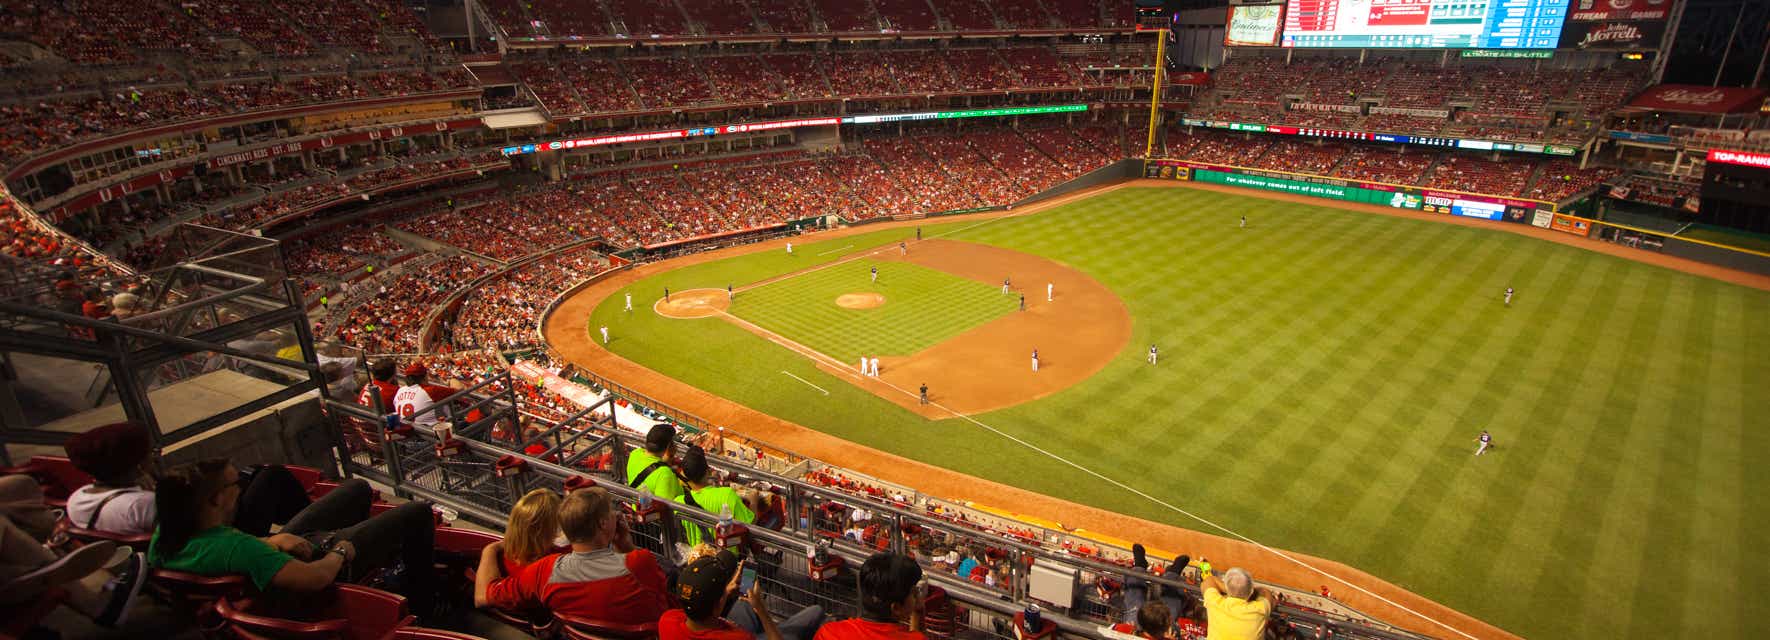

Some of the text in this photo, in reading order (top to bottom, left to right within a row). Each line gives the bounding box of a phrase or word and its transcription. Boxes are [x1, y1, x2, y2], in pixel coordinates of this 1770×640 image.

[1572, 12, 1608, 20] STREAM
[1578, 27, 1638, 48] Morrell
[1238, 178, 1265, 187] whatever
[1311, 186, 1324, 194] left
[1326, 188, 1345, 196] field.
